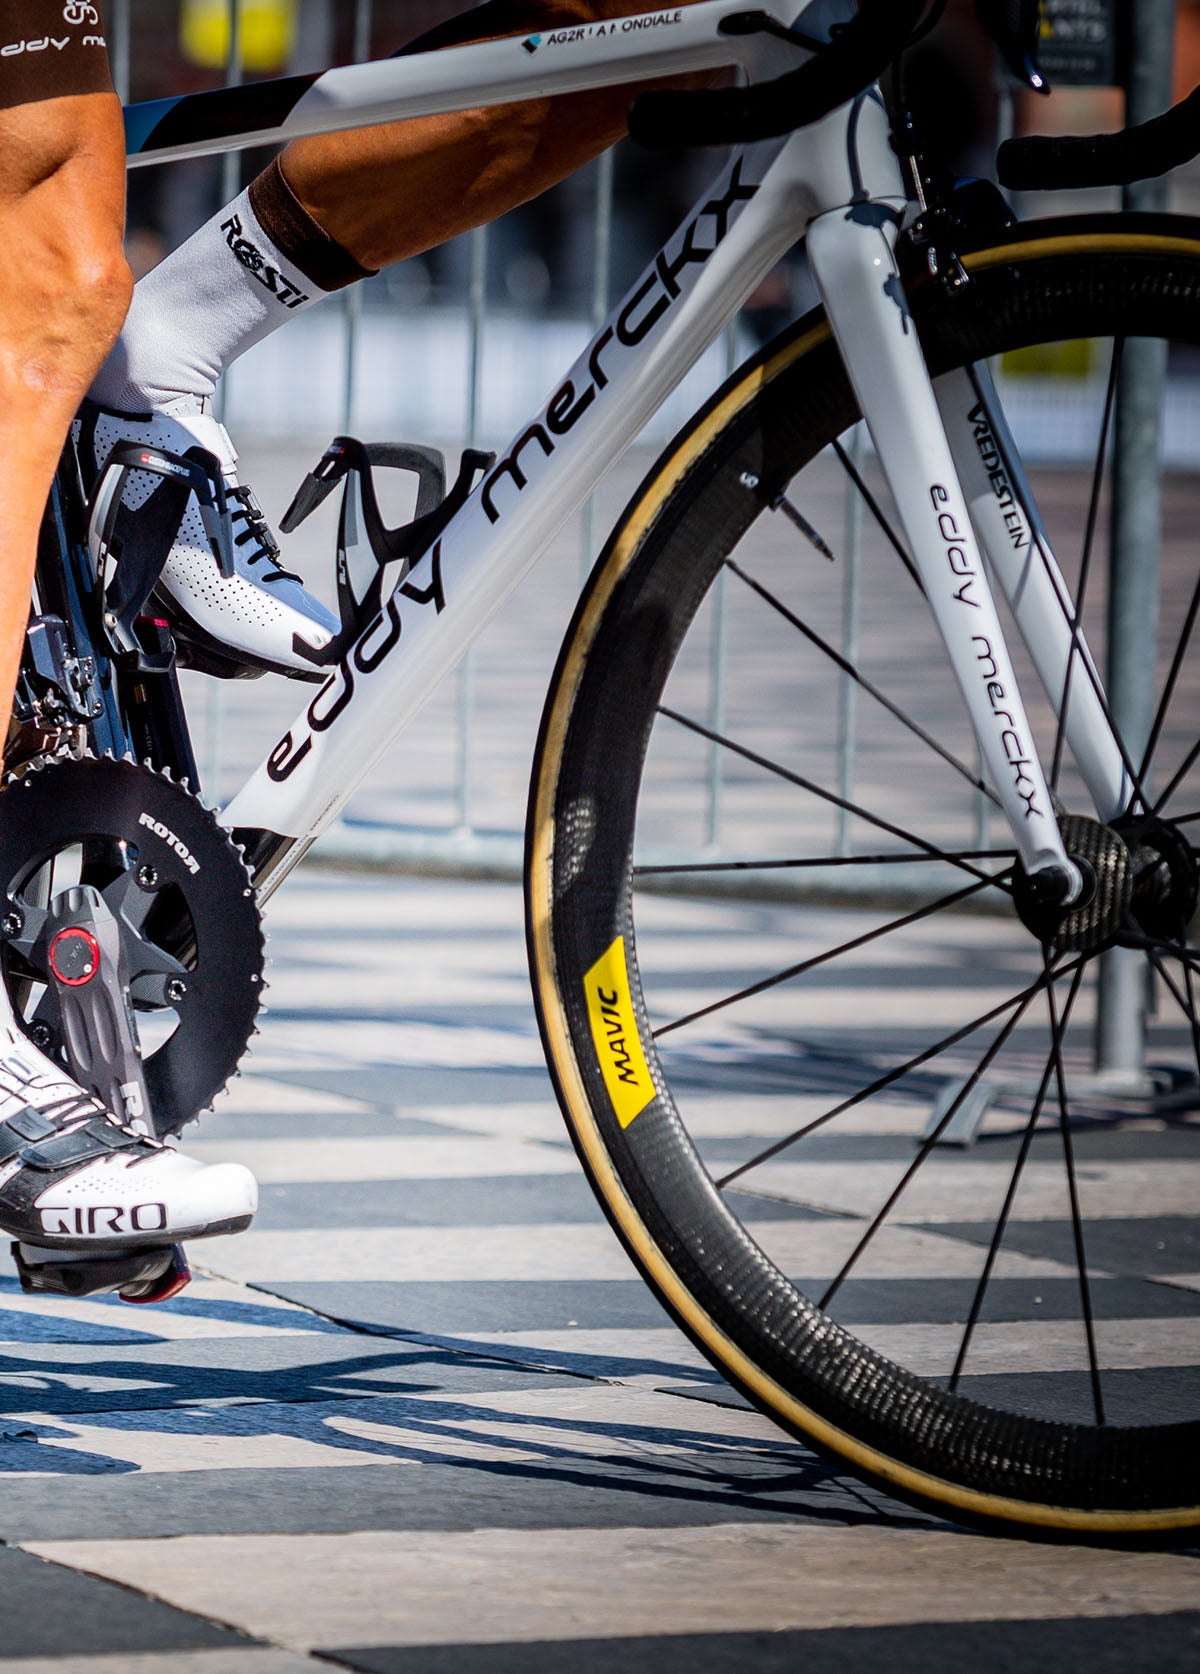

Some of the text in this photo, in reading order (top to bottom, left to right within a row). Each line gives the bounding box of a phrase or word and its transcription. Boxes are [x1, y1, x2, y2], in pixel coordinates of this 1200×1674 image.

[546, 28, 584, 45] AG2R
[267, 155, 761, 782] eddy merckx
[968, 401, 1030, 549] VREDESTEIN
[930, 484, 1044, 819] eddy merckx
[138, 812, 201, 875] ROTOR
[597, 986, 639, 1086] MAVIC
[40, 1203, 167, 1234] GIRO
